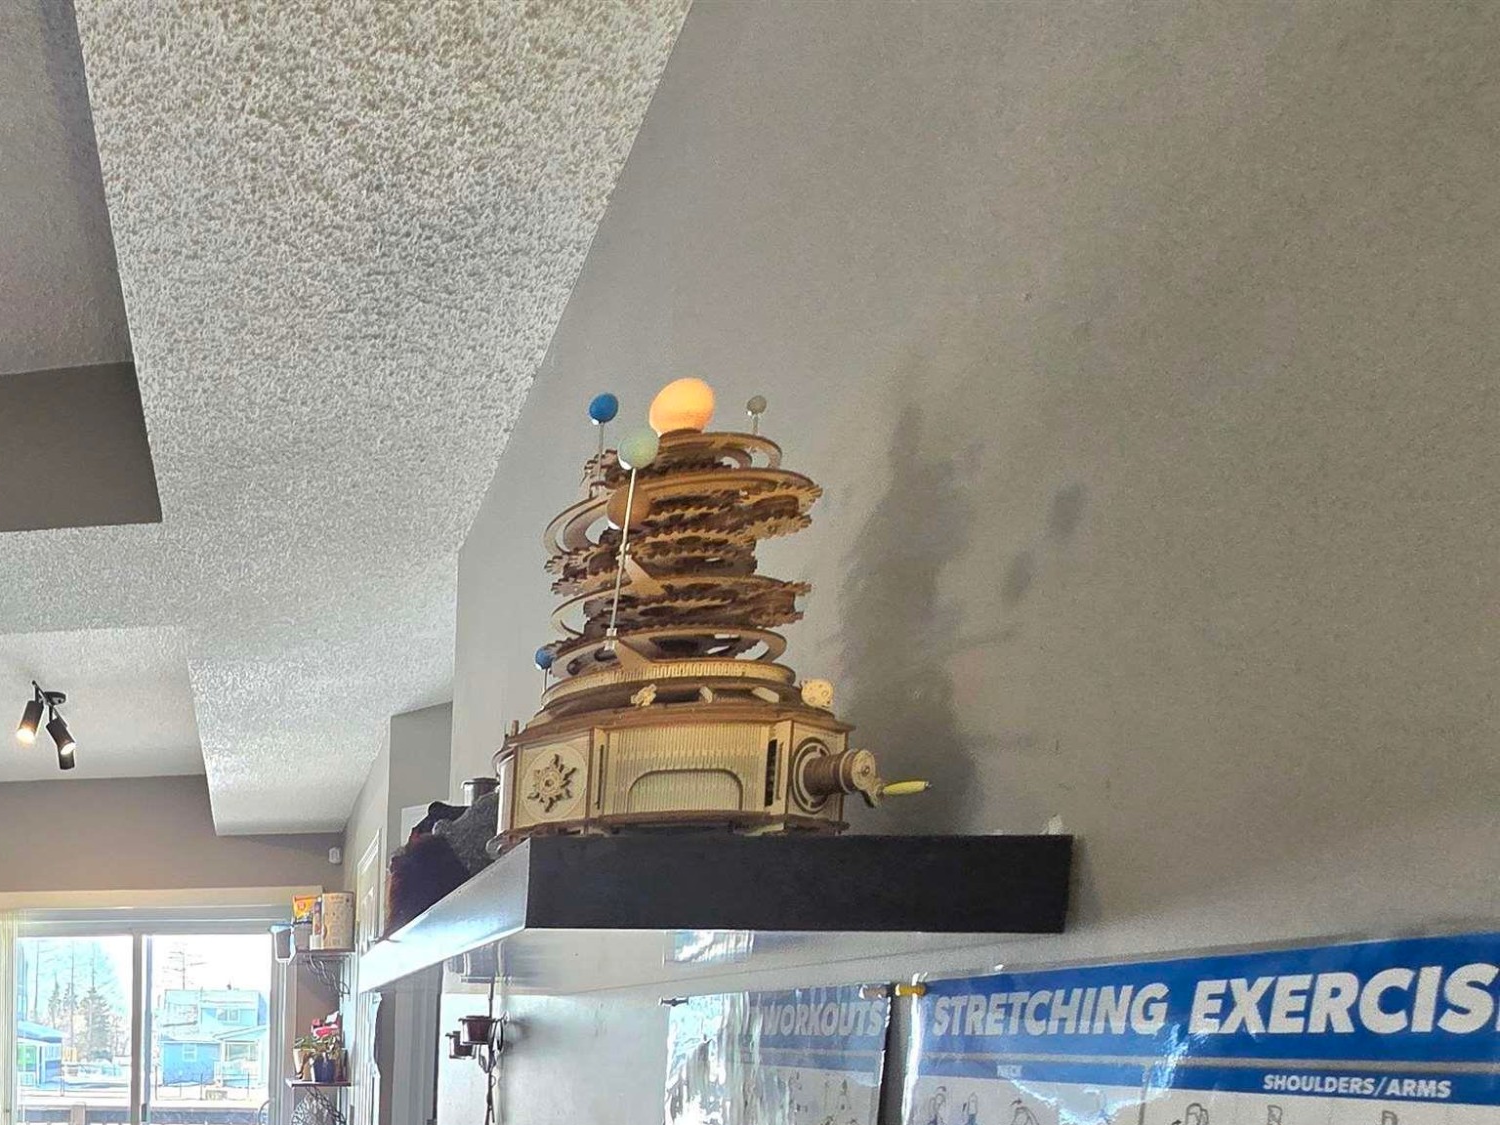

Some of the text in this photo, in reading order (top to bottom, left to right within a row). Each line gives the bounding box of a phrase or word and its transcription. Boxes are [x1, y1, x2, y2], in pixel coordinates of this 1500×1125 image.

[931, 962, 1500, 1036] STRETCHING EXERCIS
[763, 1001, 884, 1037] WORKOUTS
[1262, 1073, 1452, 1099] SHOULDERS/ARMS
